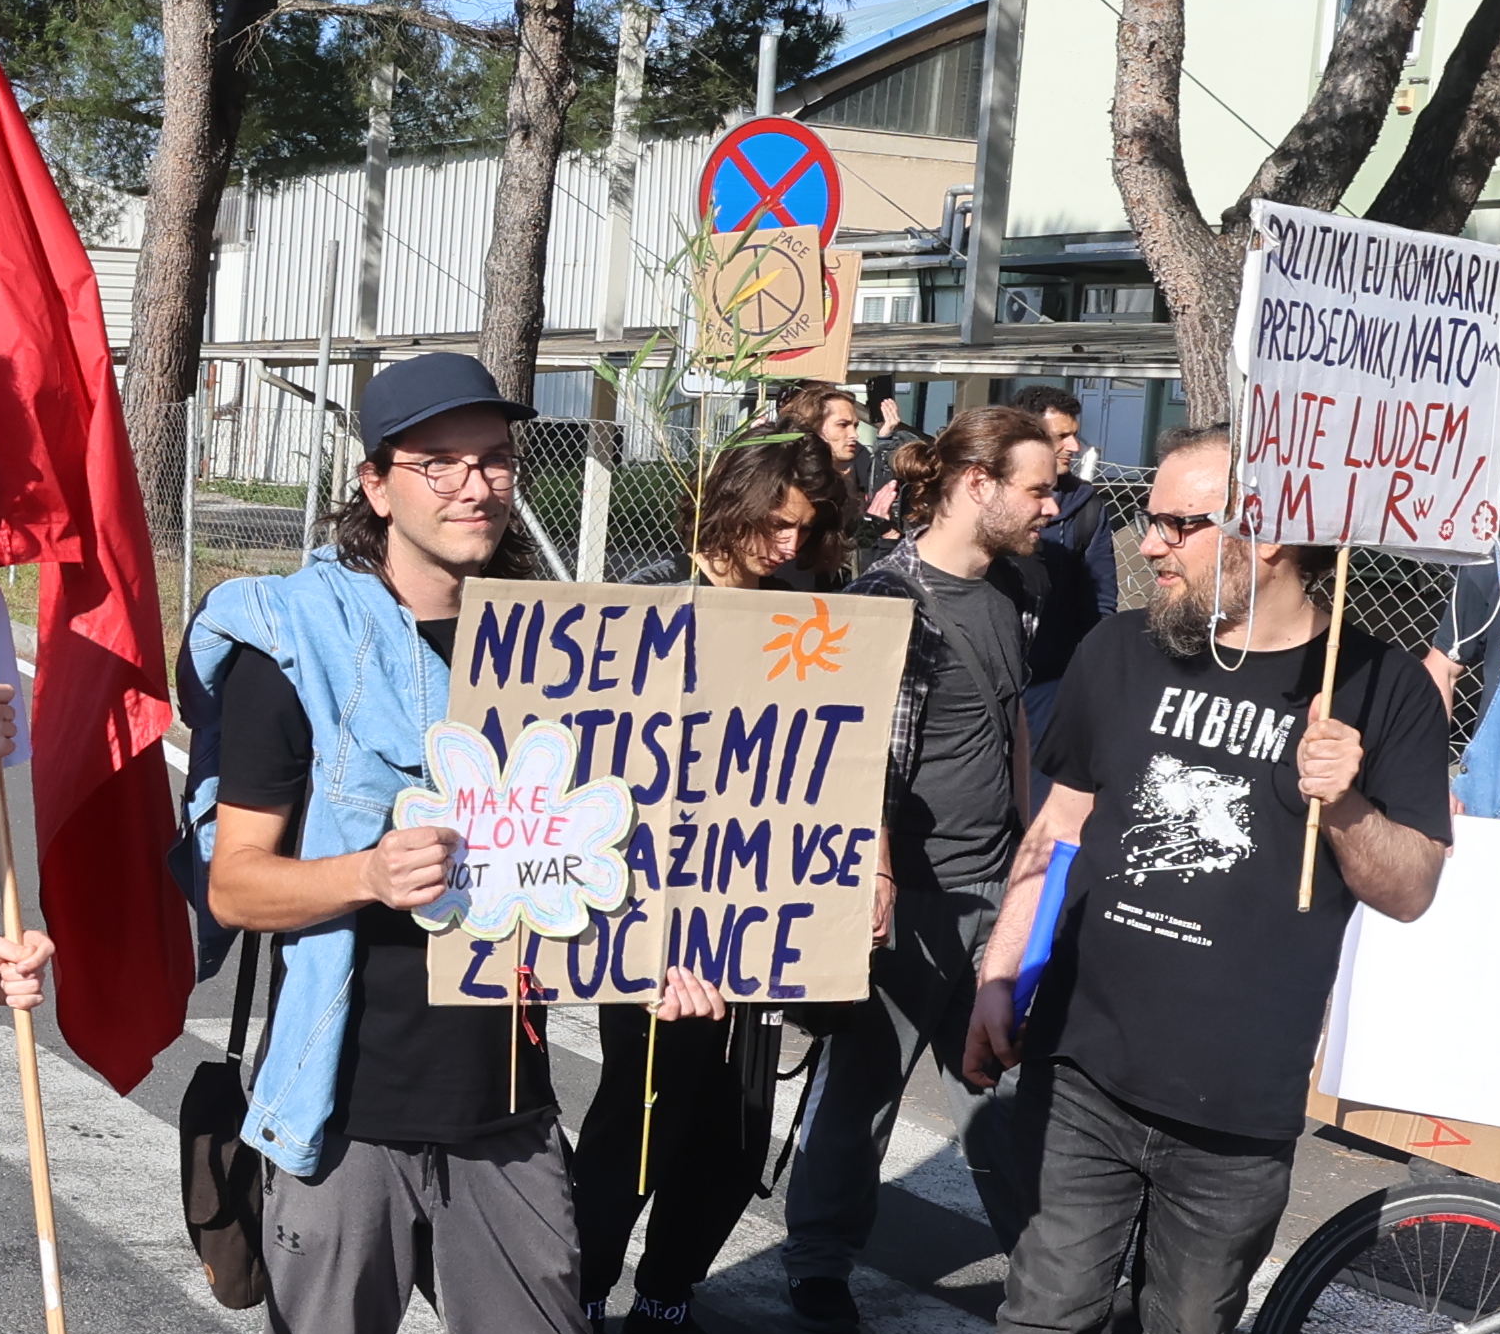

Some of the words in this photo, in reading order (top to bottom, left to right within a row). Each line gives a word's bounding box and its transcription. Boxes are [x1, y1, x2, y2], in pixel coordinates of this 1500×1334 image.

[775, 230, 810, 259] PACE
[1361, 235, 1390, 297] EU
[1391, 242, 1500, 324] KOMISARJI,
[1257, 298, 1400, 389] PREDSEDNIKI,
[1246, 383, 1336, 470] DAJTE
[1344, 396, 1470, 479] LJUDEM
[1275, 469, 1418, 544] MIR
[469, 600, 697, 700] NISEM
[1150, 686, 1296, 764] EKBOM
[455, 785, 549, 817] MAKE
[462, 816, 570, 851] LOVE
[516, 855, 587, 889] WAR
[792, 822, 876, 888] VSE
[458, 896, 815, 1002] ZLOČINCE
